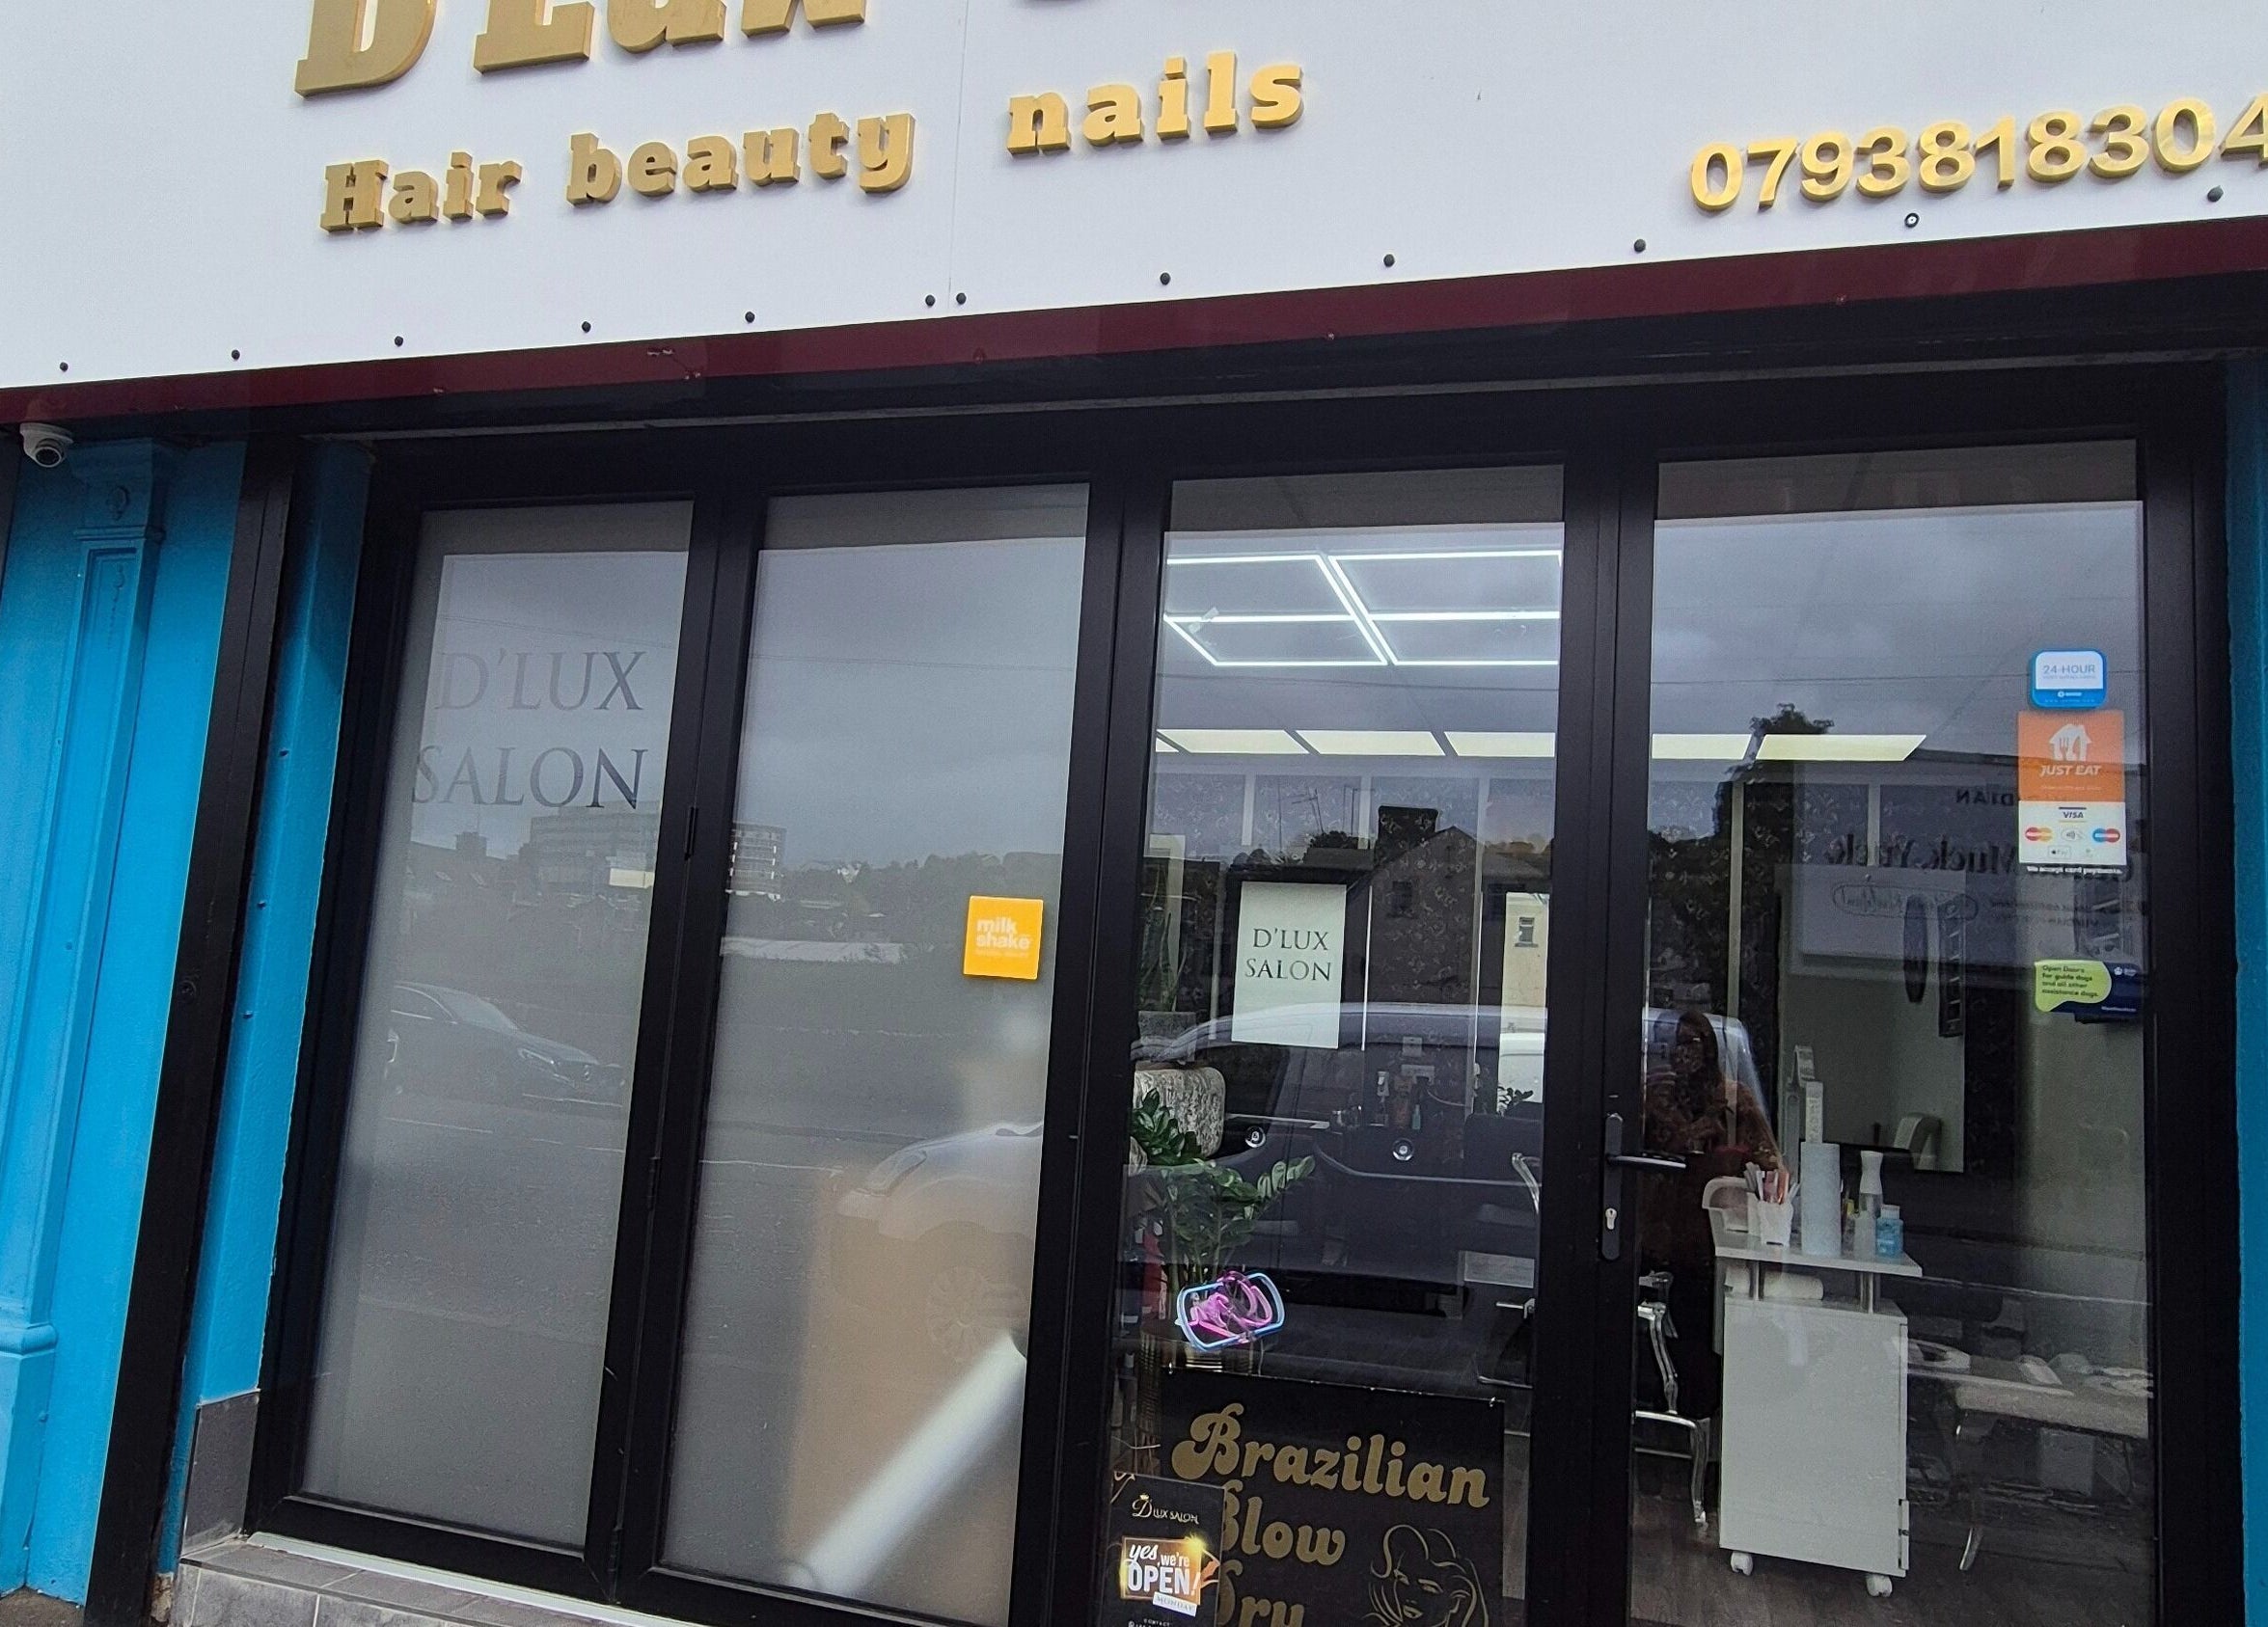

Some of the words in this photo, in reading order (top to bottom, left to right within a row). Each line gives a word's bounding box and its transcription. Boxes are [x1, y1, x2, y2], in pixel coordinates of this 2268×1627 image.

[320, 151, 522, 232] Hair
[565, 112, 915, 206] beauty
[1007, 50, 1304, 155] nails
[434, 648, 646, 711] D'LUX
[411, 746, 648, 809] SALON
[2039, 765, 2073, 777] JUST
[2075, 765, 2102, 775] EAT
[976, 917, 1018, 934] milk
[976, 932, 1030, 950] shake
[1252, 928, 1330, 951] D'LUX
[1244, 959, 1331, 982] SALON
[1172, 1403, 1489, 1507] Brazilian
